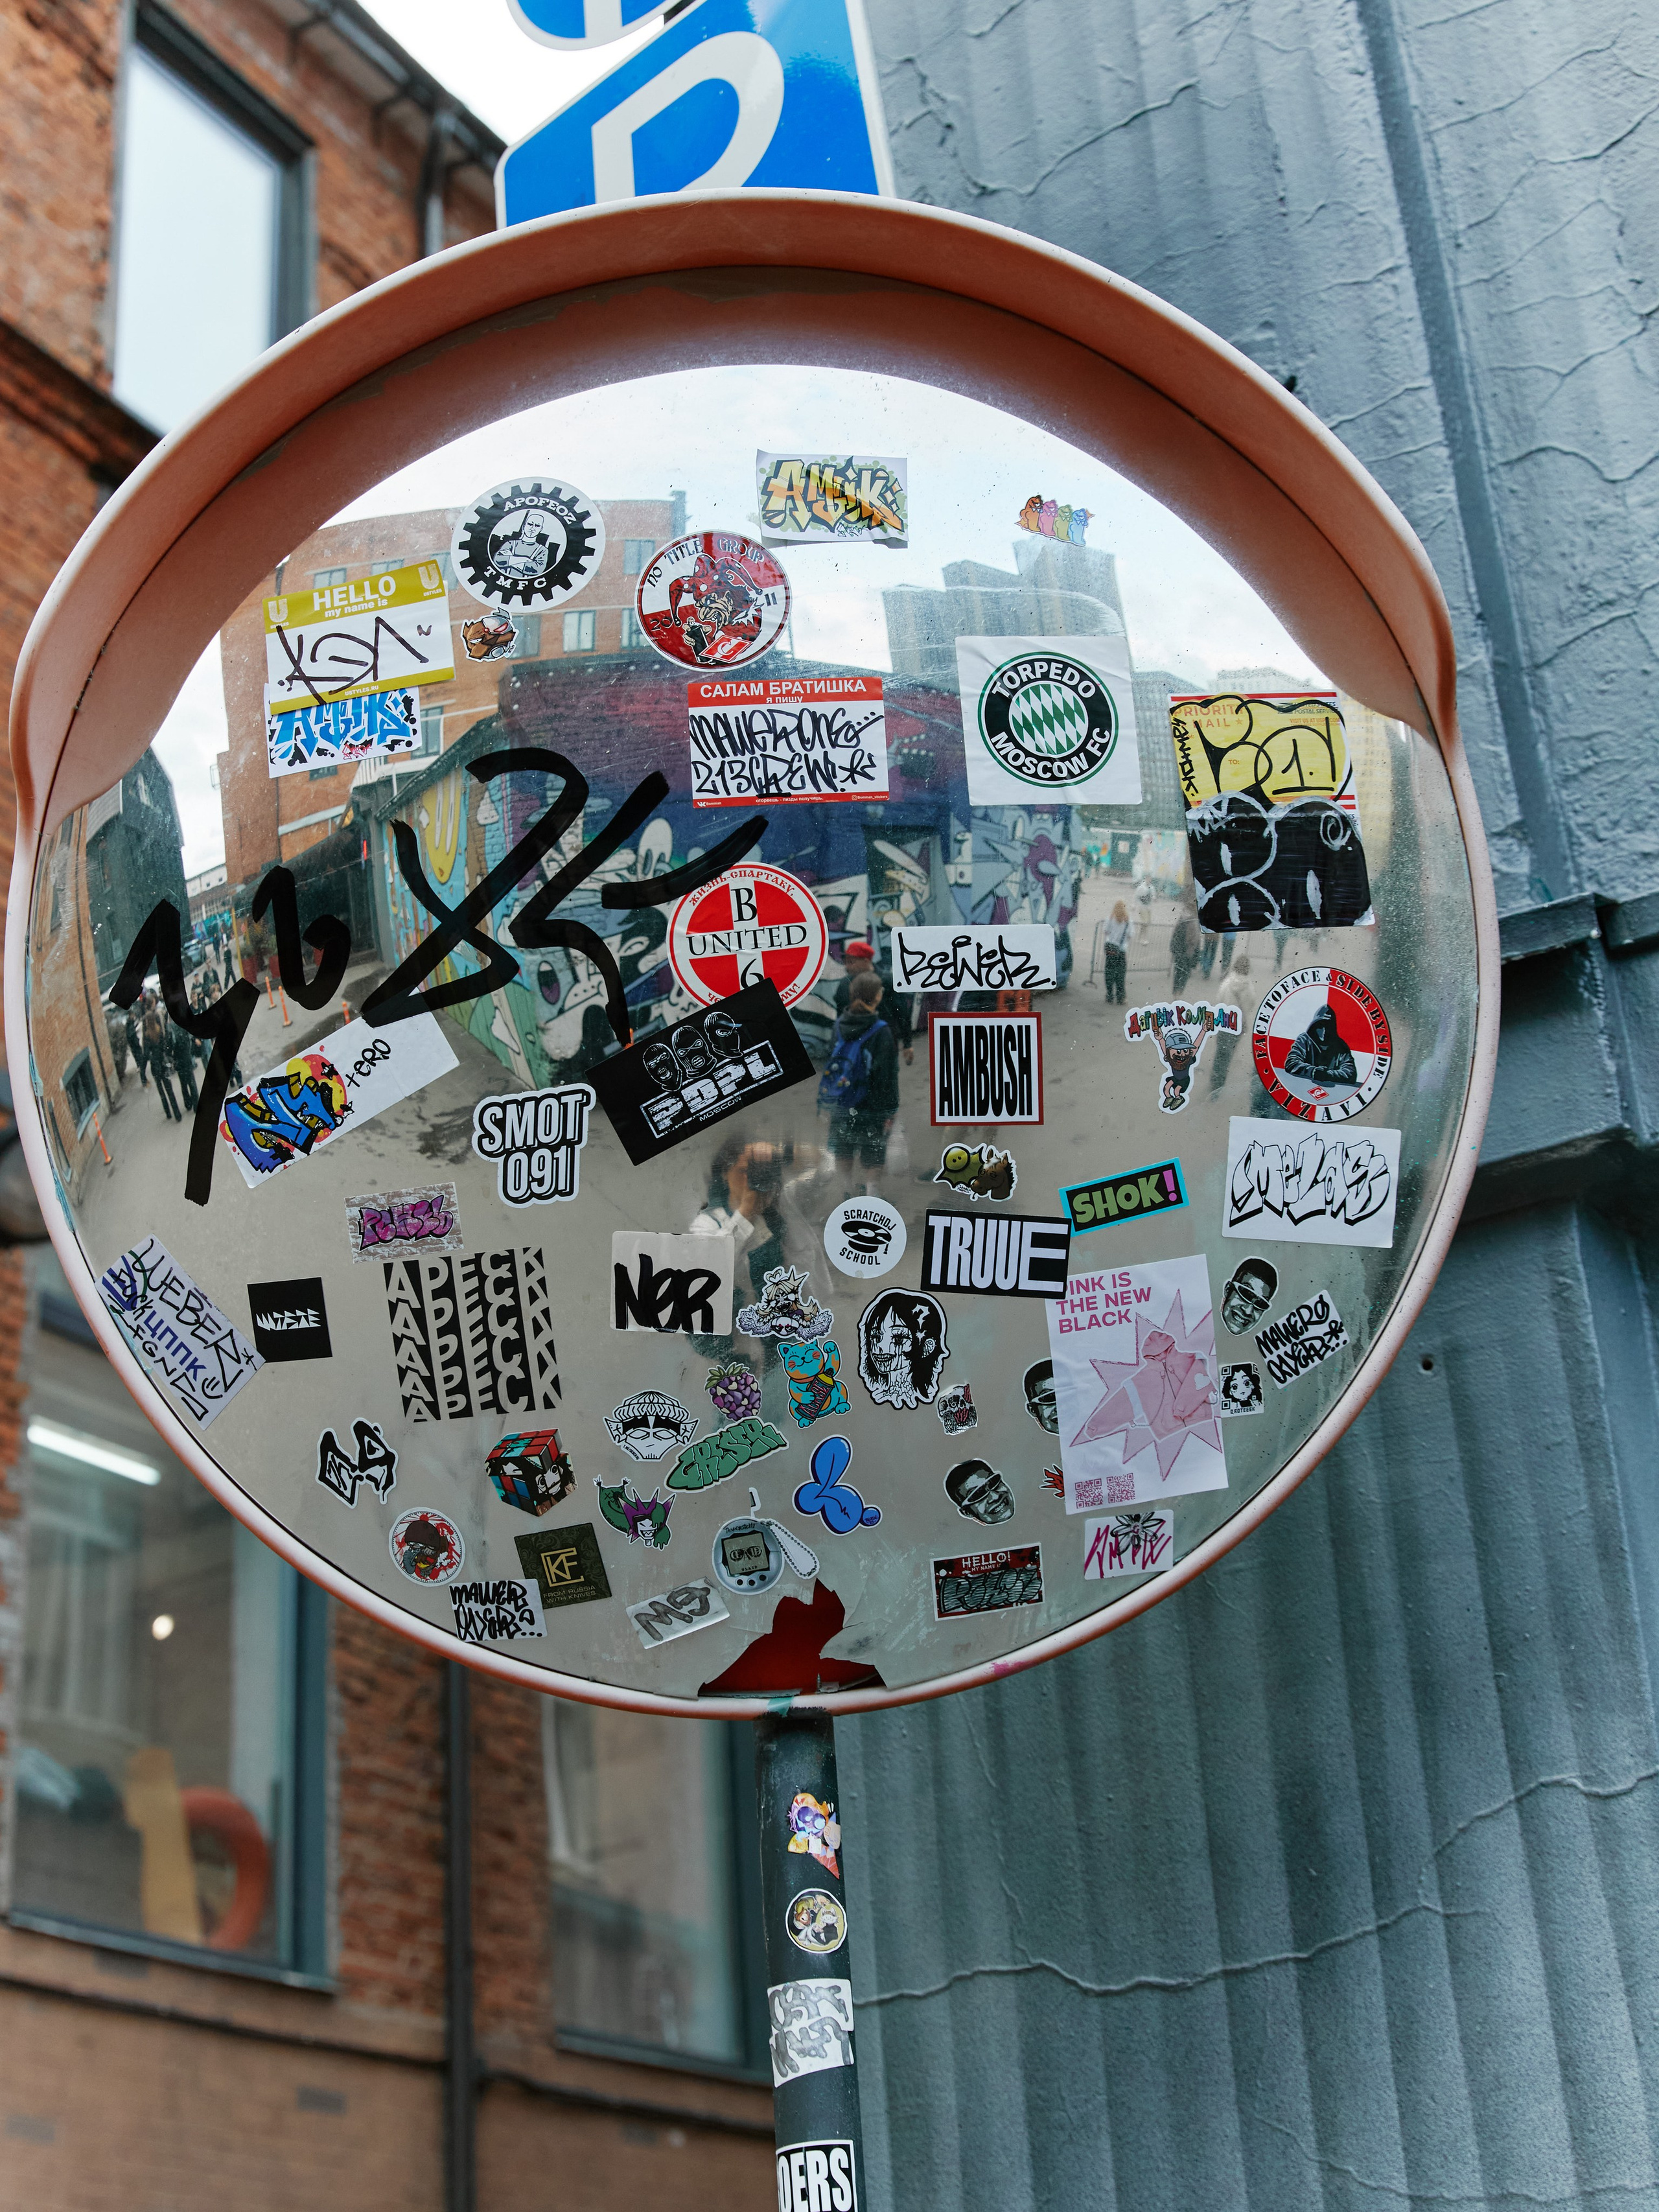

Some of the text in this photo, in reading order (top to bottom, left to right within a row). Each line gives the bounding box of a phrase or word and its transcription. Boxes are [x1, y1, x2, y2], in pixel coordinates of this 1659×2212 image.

[504, 496, 577, 525] APOFEOZ
[664, 538, 703, 565] TITLE
[717, 537, 765, 564] GROUP
[483, 565, 547, 590] TMFC
[313, 576, 396, 611] HELLO
[325, 598, 388, 618] my name is
[345, 685, 379, 697] USTYLES.RU
[700, 679, 866, 698] САЛАМ БРАТИШКА
[992, 661, 1096, 700] TORPEDO
[990, 727, 1111, 779] MOSCOW FC
[686, 924, 807, 956] UNITED
[939, 1025, 1032, 1117] AMBUSH
[699, 1095, 742, 1122] MOSCOW
[1268, 1078, 1367, 1121] VIZAVI
[481, 1093, 586, 1152] SMOT
[507, 1147, 570, 1198] 091
[1073, 1169, 1177, 1224] SHOK!
[844, 1209, 896, 1231] SCRATCHDJ
[839, 1247, 880, 1265] SCHOOL
[928, 1215, 1069, 1292] TRUUE
[1066, 1272, 1131, 1295] INK IS
[1056, 1287, 1151, 1315] THE NEW
[1059, 1309, 1132, 1334] BLACK
[143, 1310, 206, 1381] ЦППК
[962, 1552, 1012, 1569] HELLO!
[543, 1585, 596, 1598] FROM RUSSIA
[568, 1590, 596, 1599] KNIVES
